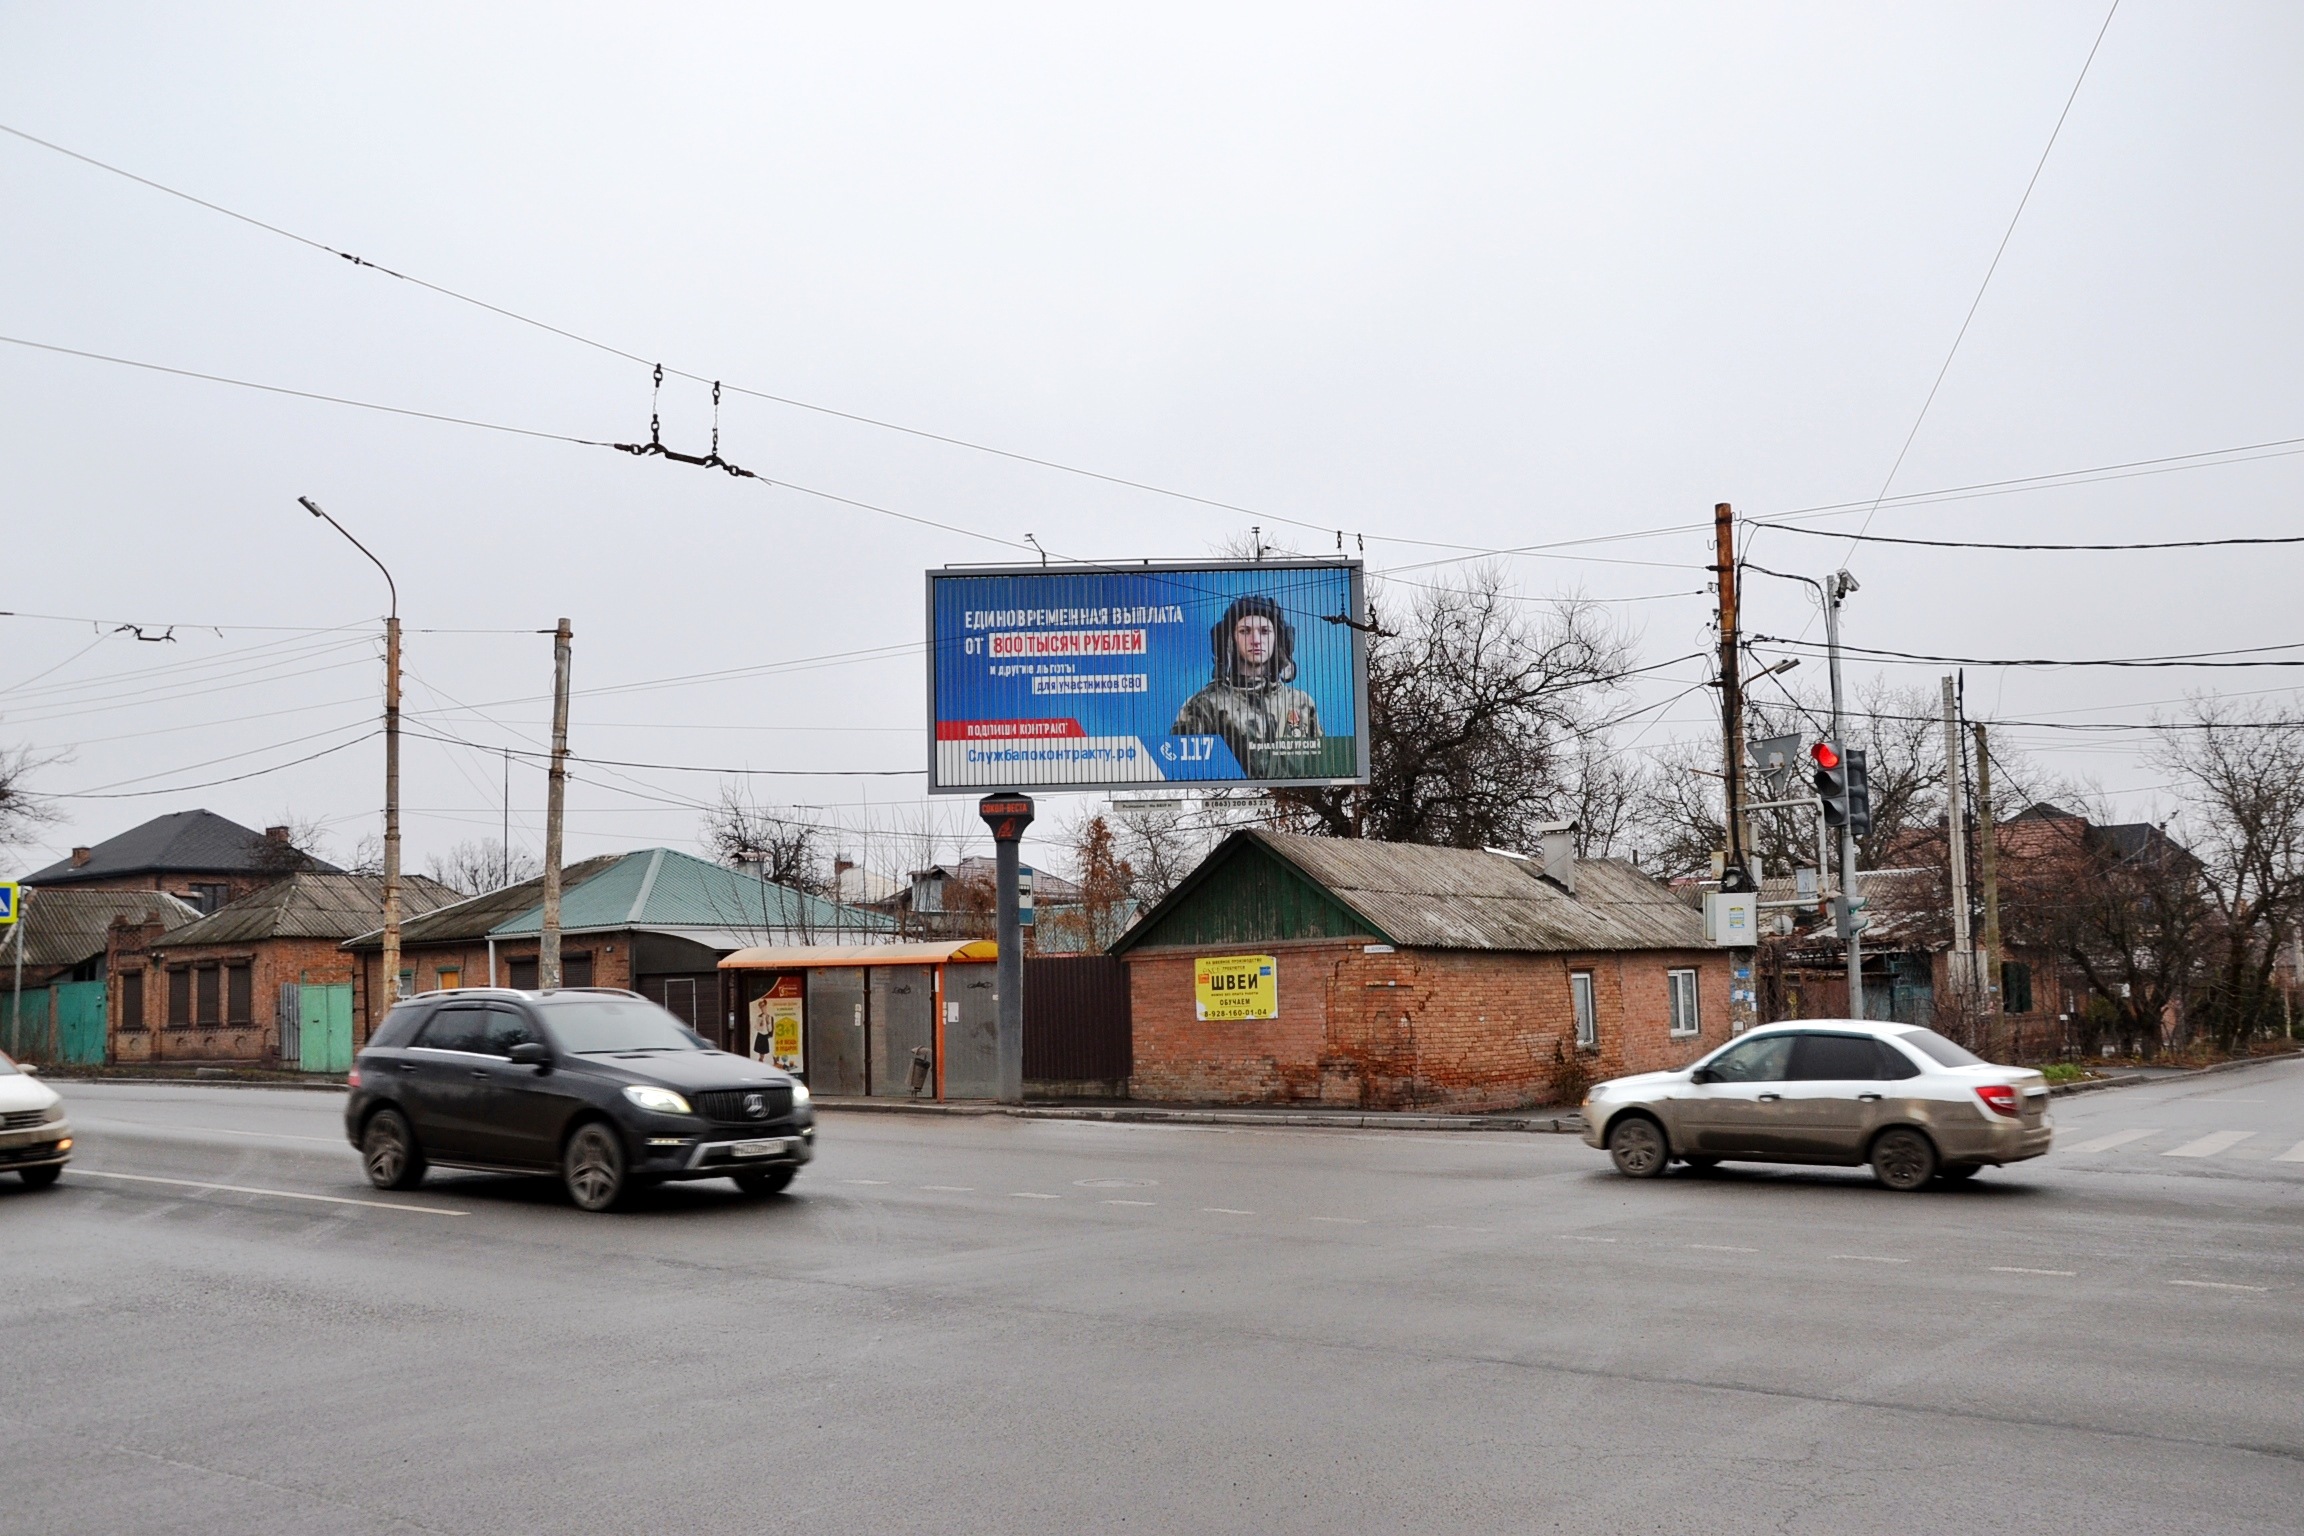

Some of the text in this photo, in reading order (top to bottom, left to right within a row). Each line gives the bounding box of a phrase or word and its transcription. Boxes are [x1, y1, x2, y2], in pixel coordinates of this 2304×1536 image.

[965, 605, 1184, 630] ЕДИНОВРЕМЕННАЯ ВЫПЛАТА
[965, 630, 1142, 655] ОТ 800 ТЫСЯЧ РУБЛЕЙ
[989, 663, 1075, 677] и другие льготы
[1037, 677, 1141, 692] для участников СВО
[967, 722, 1068, 737] ПОДПИШИ КОНТРАКТ
[968, 745, 1136, 764] Службапоконтракту.рф
[1181, 737, 1214, 761] 117
[1211, 800, 1231, 808] (863)
[1211, 973, 1258, 991] ШВЕИ
[1219, 998, 1250, 1006] ОБУЧАЕМ
[1204, 1009, 1267, 1017] 8-928-160-01-04
